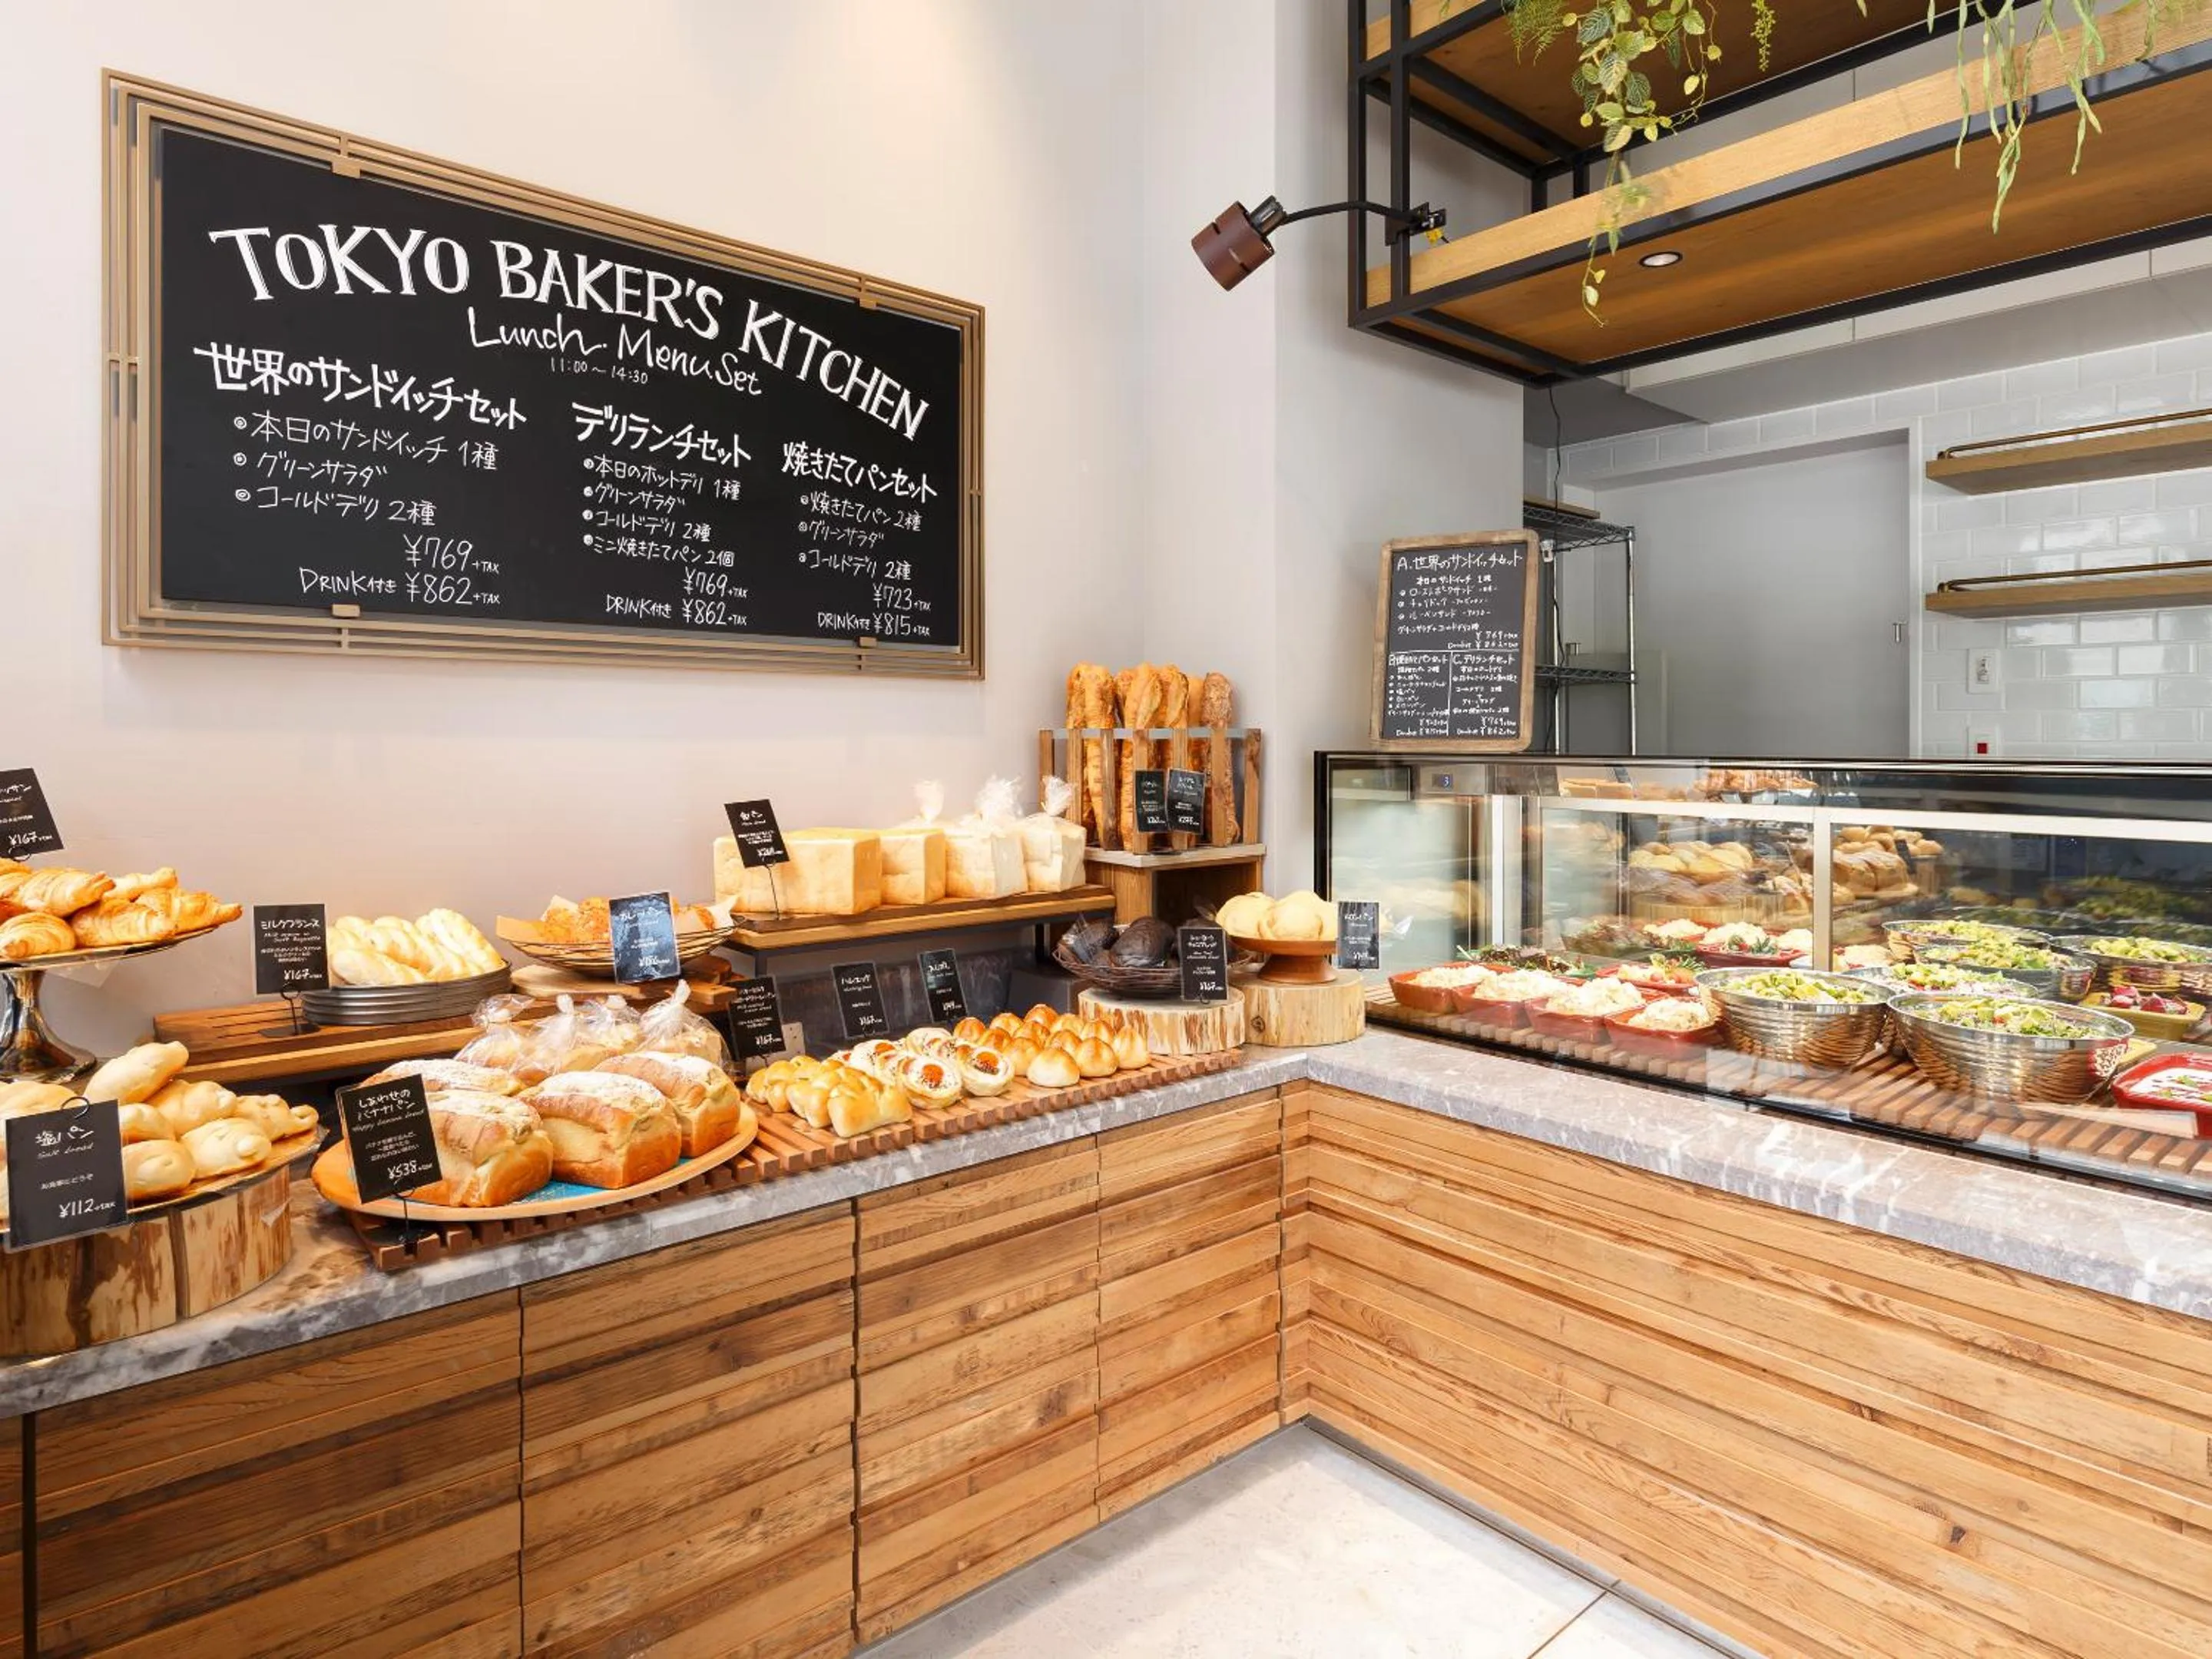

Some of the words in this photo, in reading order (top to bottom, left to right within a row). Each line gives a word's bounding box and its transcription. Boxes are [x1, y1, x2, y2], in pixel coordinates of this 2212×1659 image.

[208, 224, 470, 300] TOKYO
[490, 240, 724, 339] BAKER'S
[738, 299, 929, 441] KITCHEN
[193, 342, 527, 429] 世界のサンドイッチセット
[716, 349, 762, 395] Set
[572, 402, 751, 468] デリランチセット
[257, 451, 387, 487] グリーンサラダ
[781, 441, 937, 503] 焼きたてパンセット
[257, 486, 379, 521] コールドデリ
[595, 482, 684, 513] グリーンサラダ
[810, 521, 883, 548] グリーンサラダ
